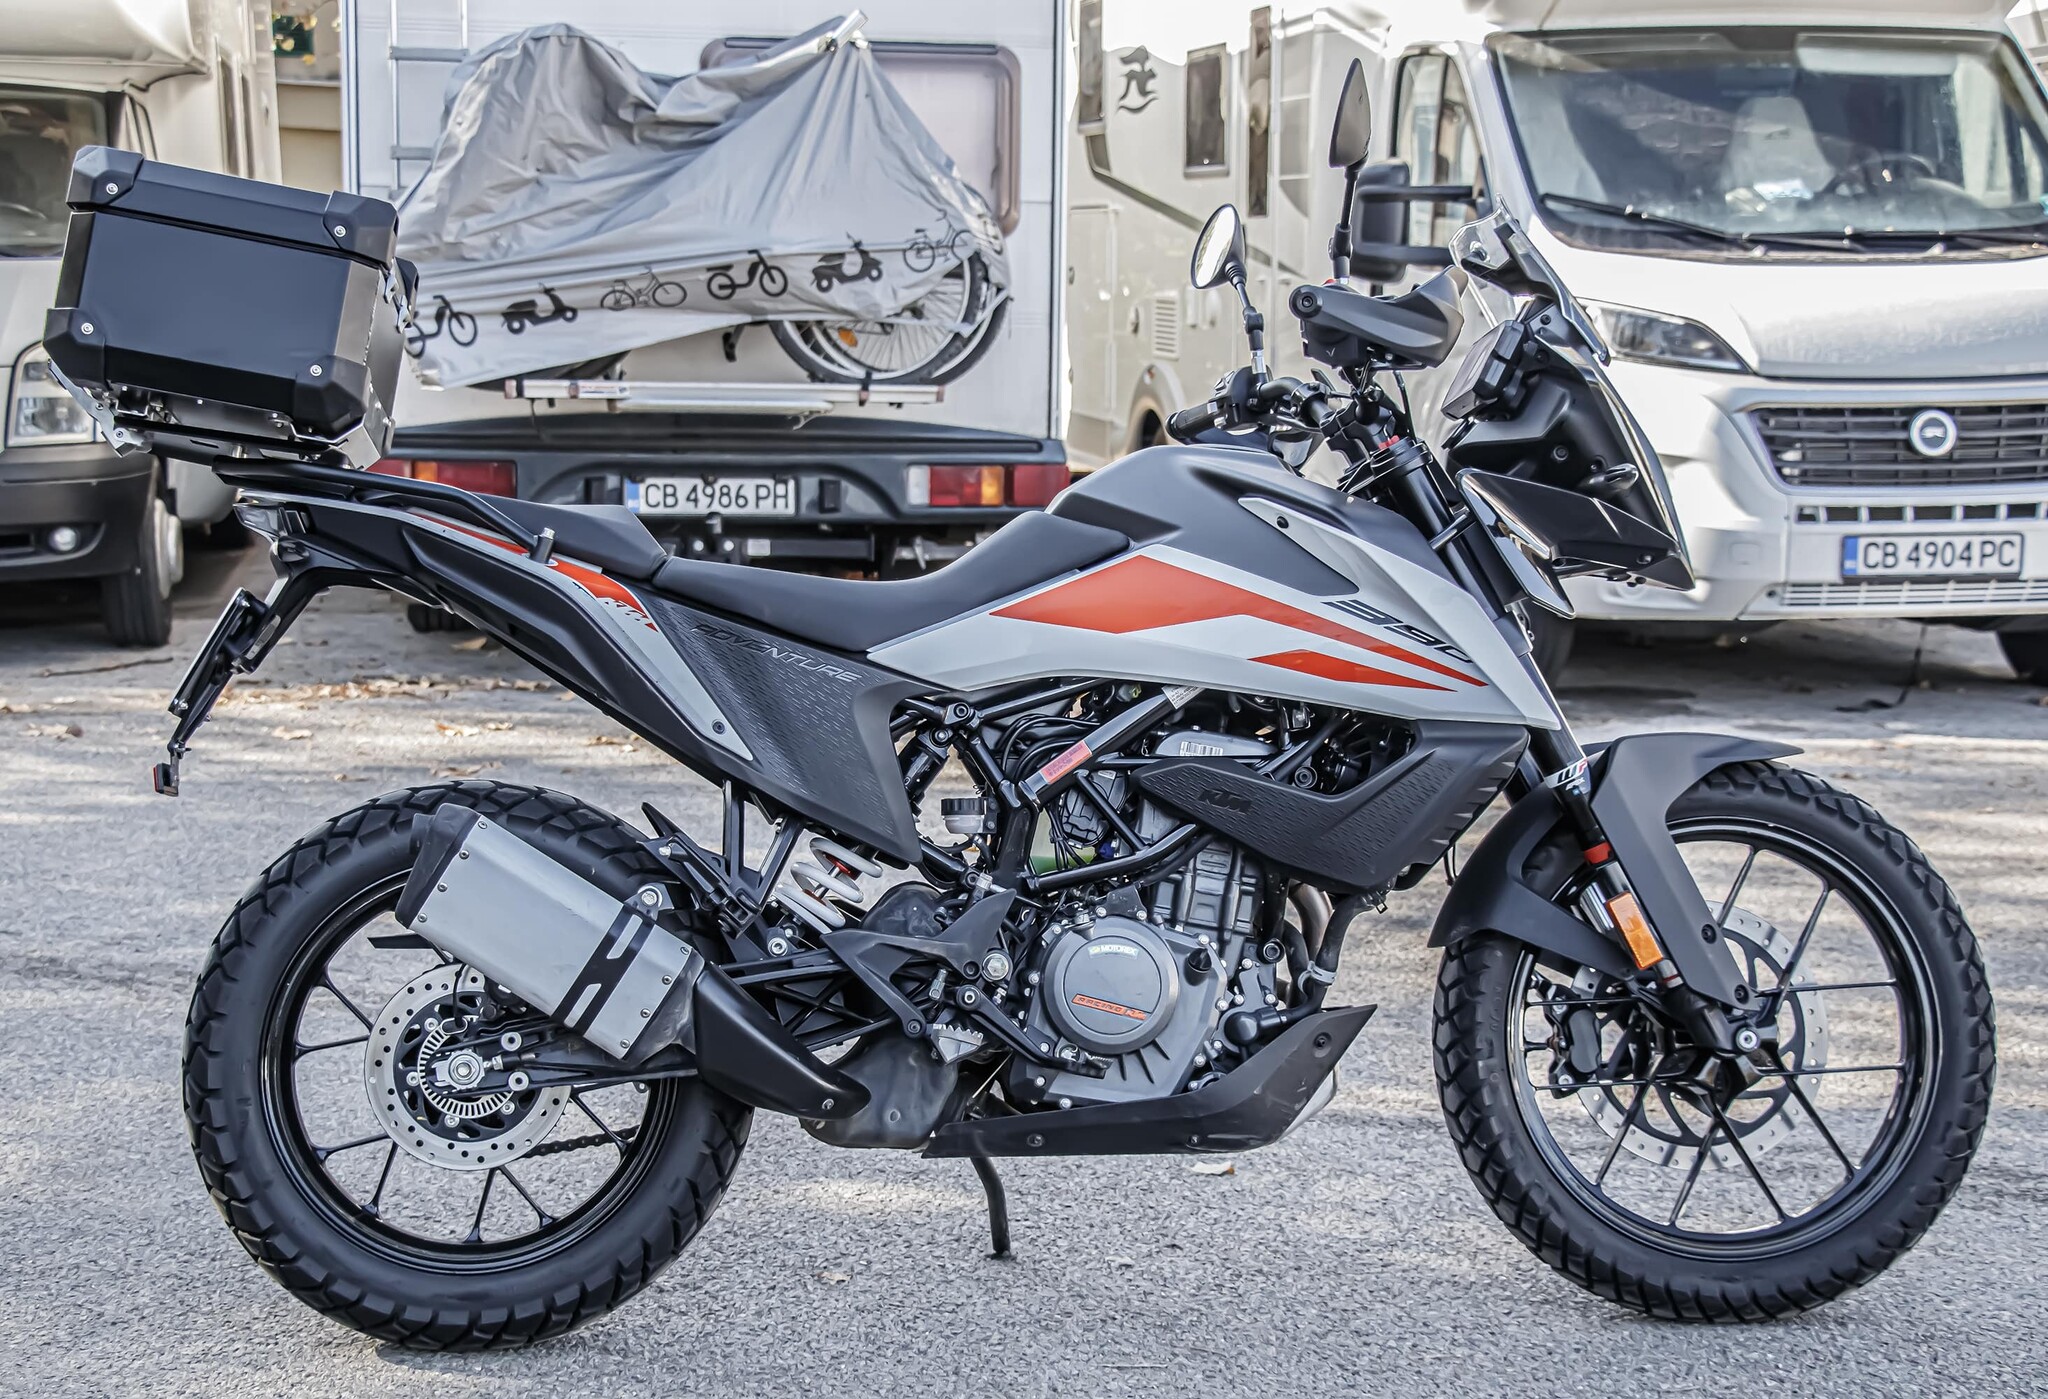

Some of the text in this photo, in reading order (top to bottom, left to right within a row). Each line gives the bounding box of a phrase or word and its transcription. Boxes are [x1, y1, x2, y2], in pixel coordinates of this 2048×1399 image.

[645, 483, 789, 509] CB 4986 PH
[1863, 539, 2016, 569] CB 4904 PC
[690, 623, 863, 683] ADVENTURE
